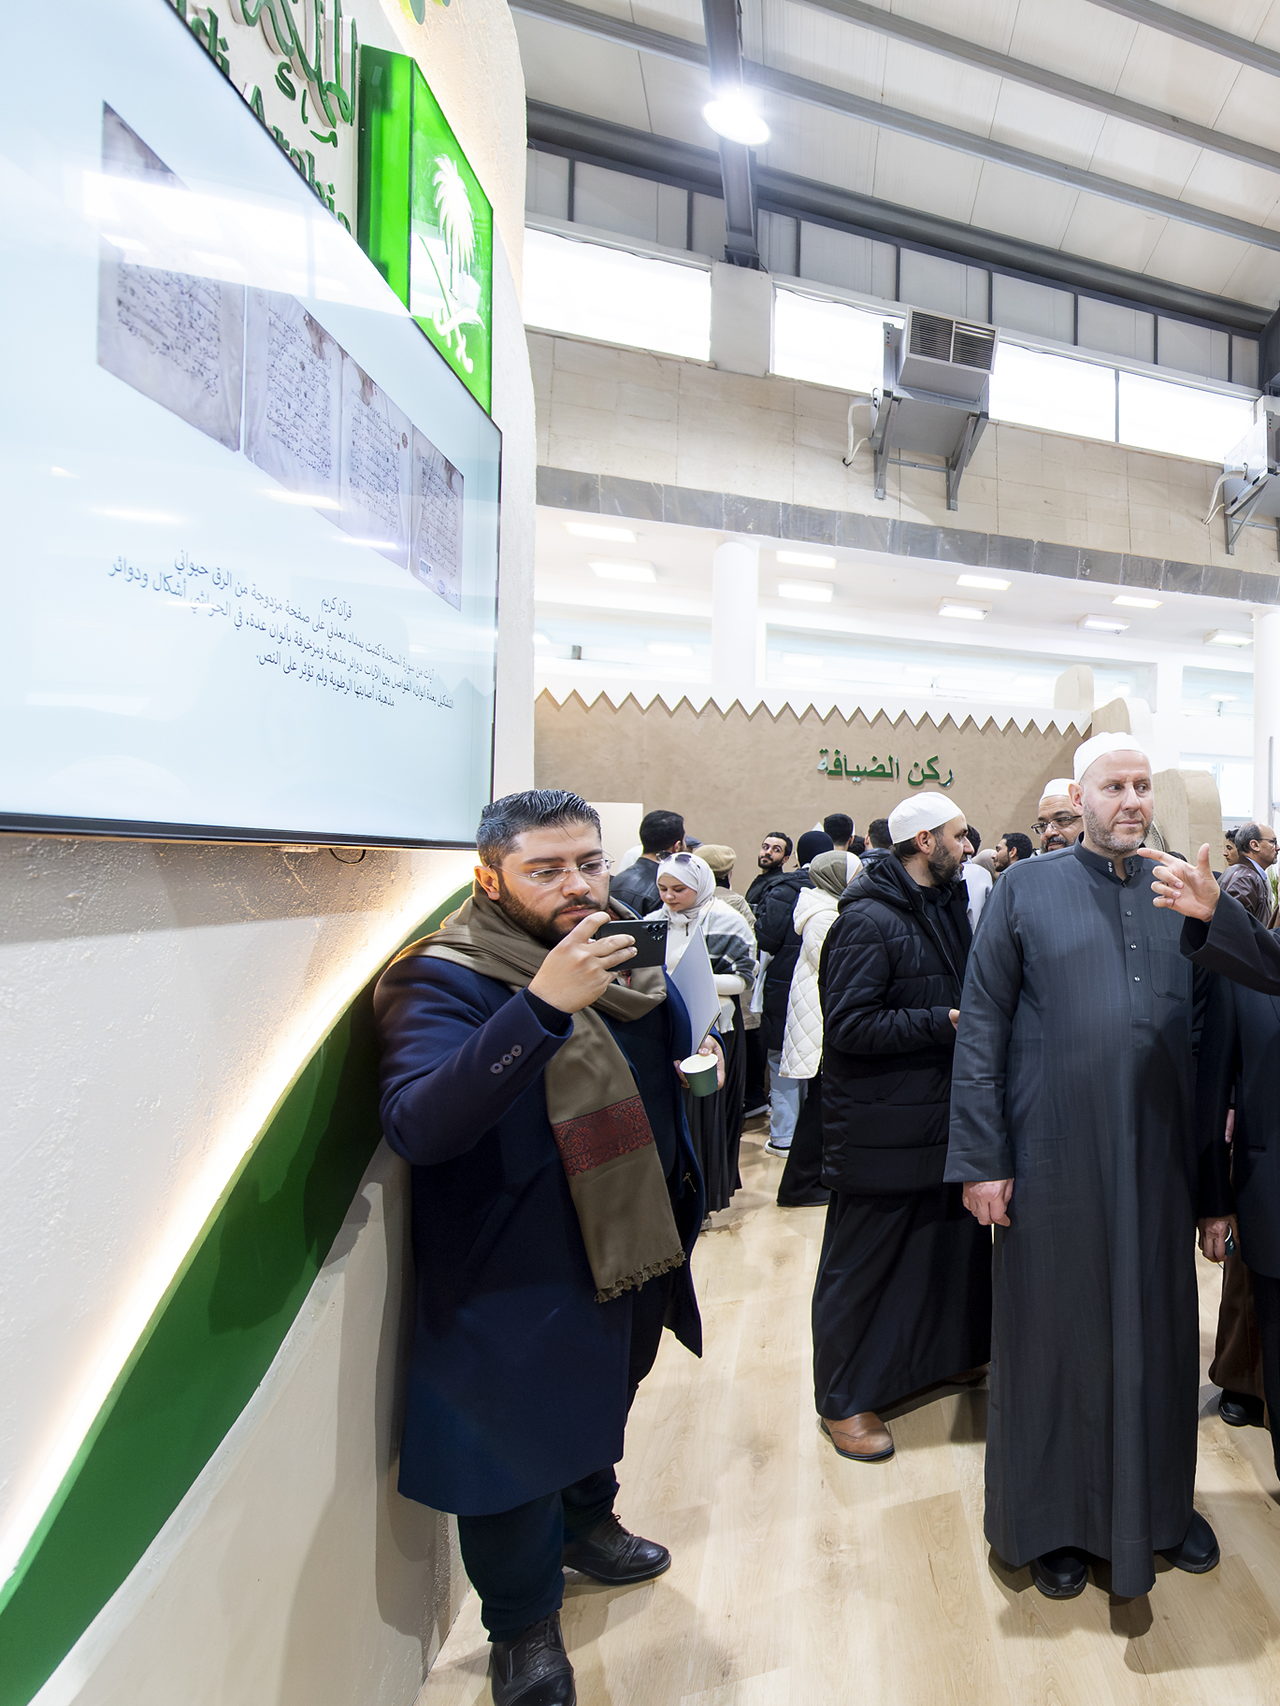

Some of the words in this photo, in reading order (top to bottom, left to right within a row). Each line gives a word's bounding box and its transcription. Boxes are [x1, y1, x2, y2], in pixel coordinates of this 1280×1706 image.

[108, 555, 148, 588] ودوائر
[174, 548, 208, 576] حيواني
[153, 571, 186, 599] أشكال
[212, 567, 232, 590] الرق
[234, 581, 248, 597] من
[251, 583, 283, 614] مزدوجة
[321, 596, 338, 613] كريم
[338, 600, 352, 621] قرآن
[234, 605, 242, 631] في
[285, 599, 310, 623] صفحة
[312, 614, 325, 632] على
[269, 622, 292, 647] بألوان
[327, 621, 346, 642] معدني
[294, 631, 324, 660] ومزخرفة
[283, 655, 297, 674] على
[298, 661, 314, 682] تؤثر
[316, 667, 328, 687] ولم
[816, 748, 900, 783] الضيافة
[907, 755, 954, 787] ركن
